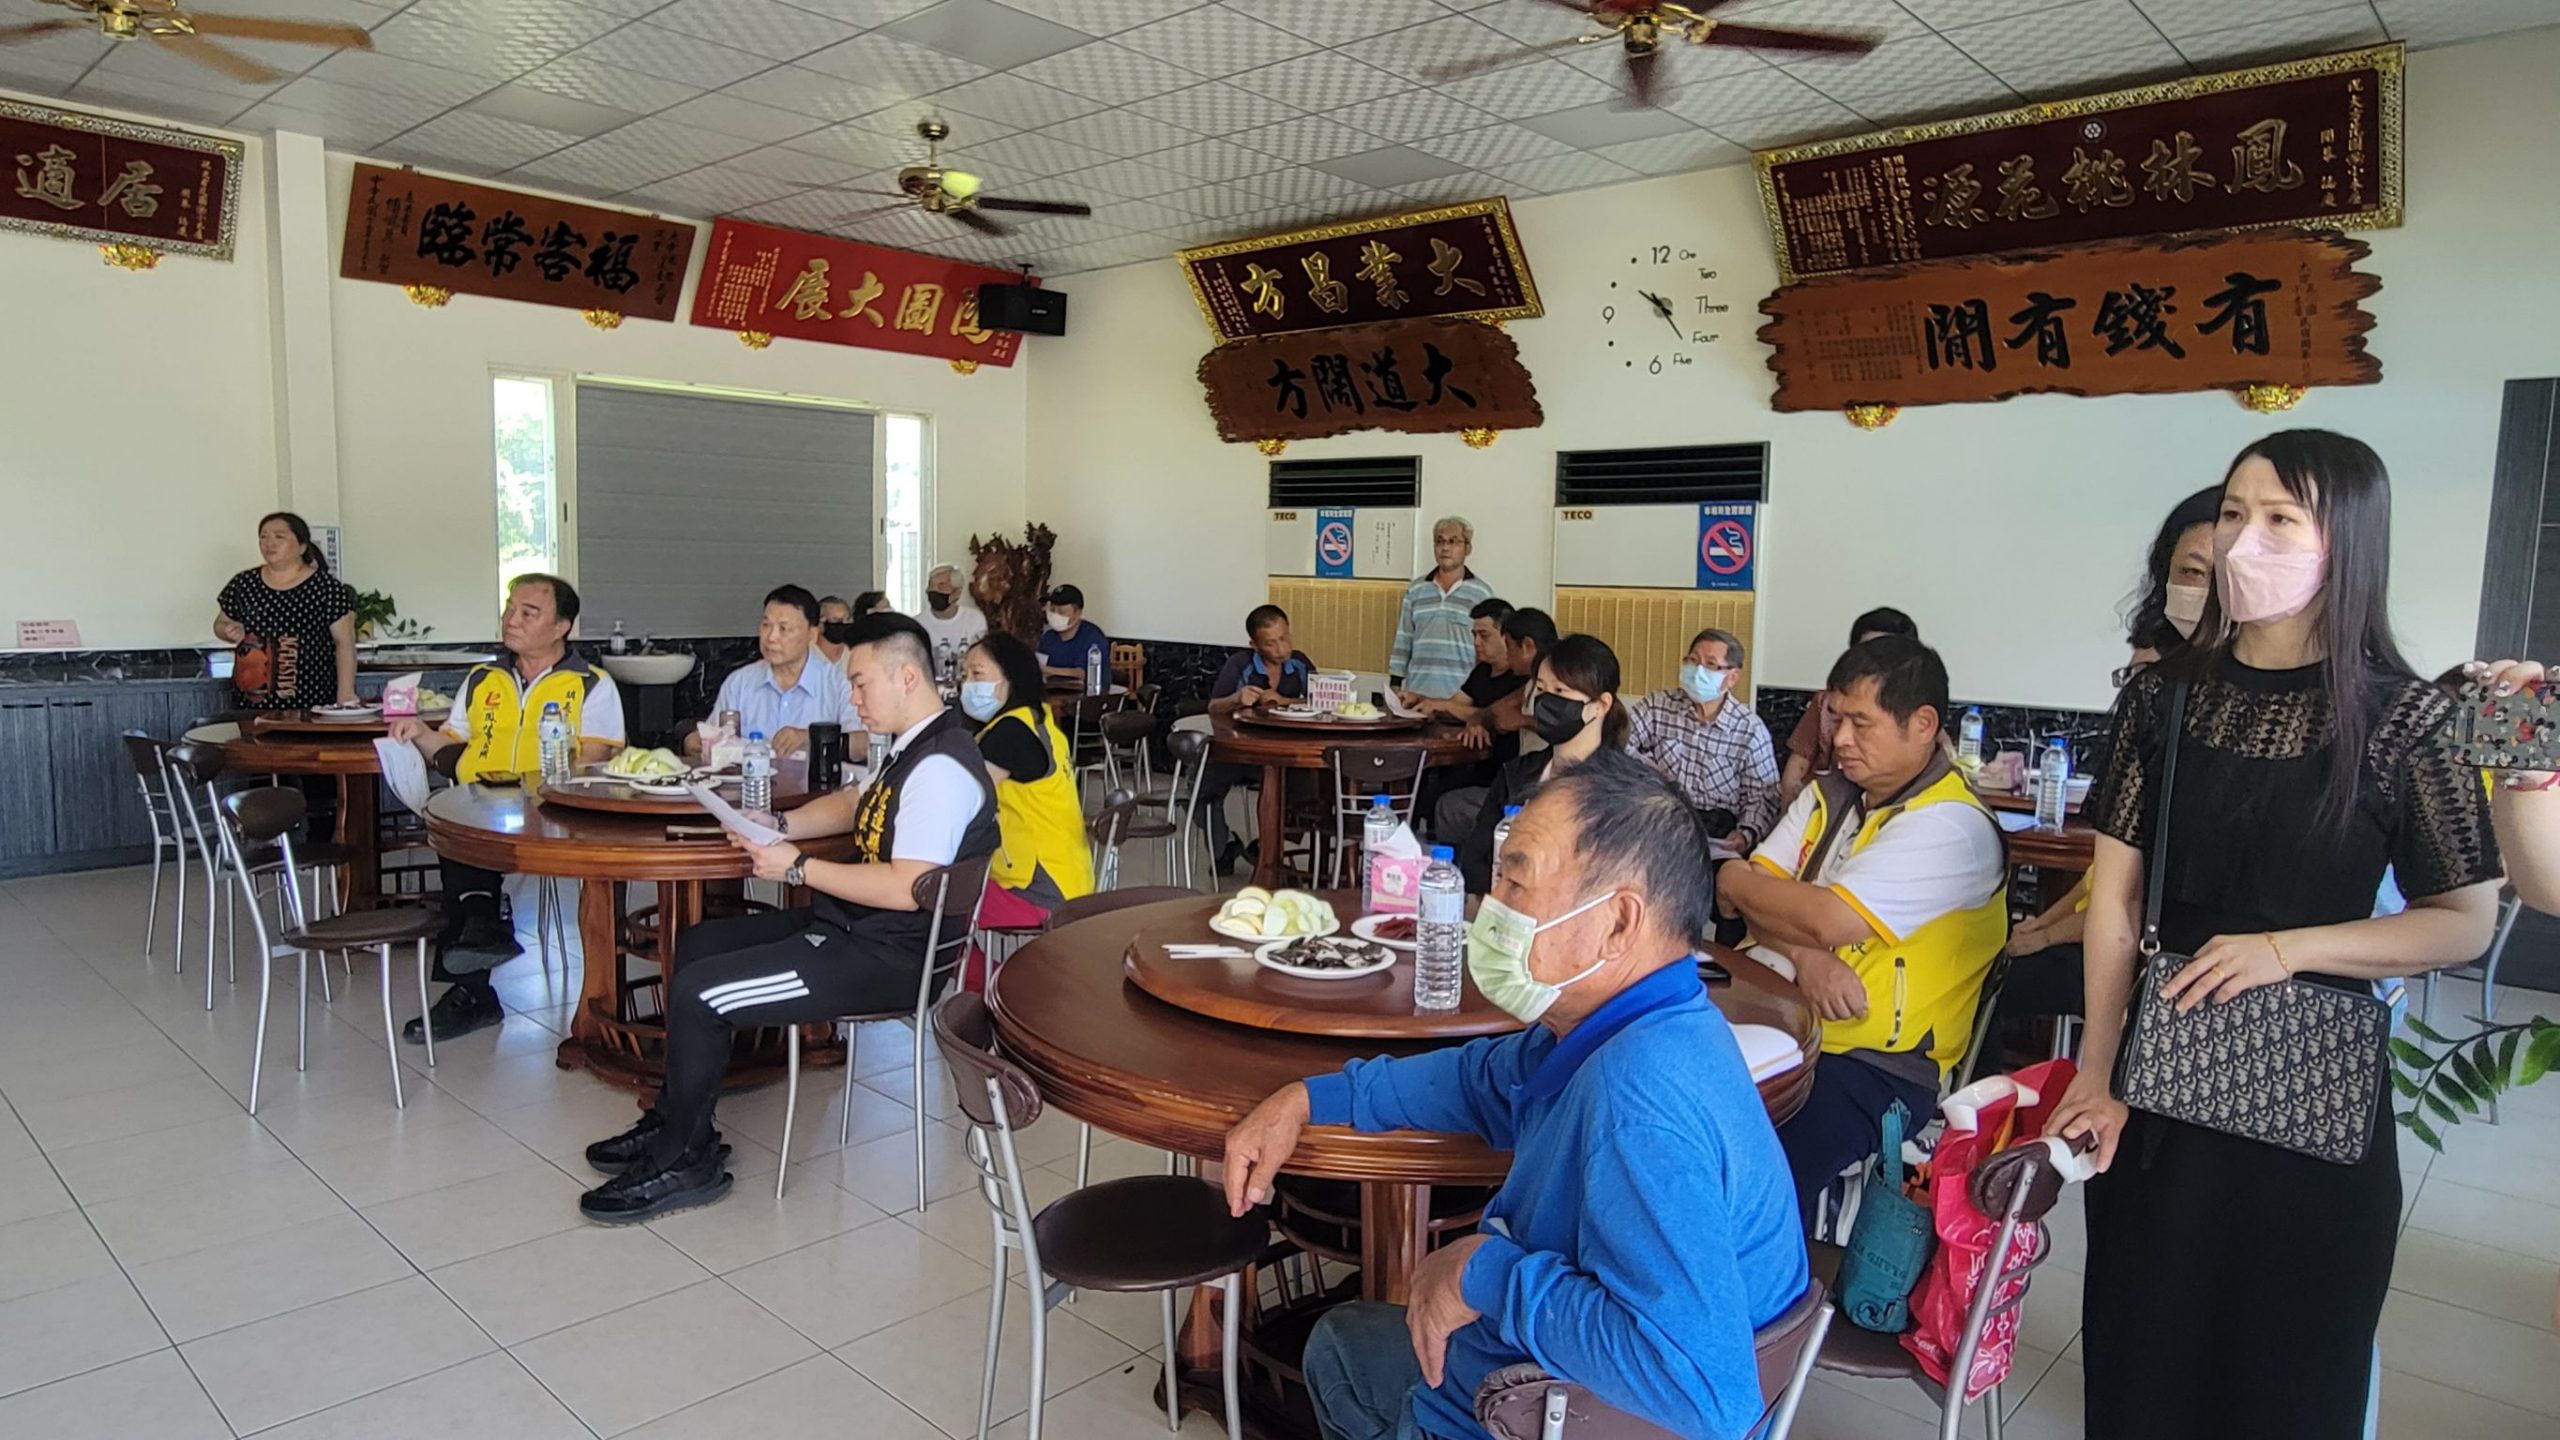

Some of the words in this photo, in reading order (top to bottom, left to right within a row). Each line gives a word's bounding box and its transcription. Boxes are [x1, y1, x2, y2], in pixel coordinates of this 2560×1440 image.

[1651, 245, 1671, 264] 12
[1678, 249, 1697, 261] One
[1698, 267, 1717, 280] Two
[1602, 305, 1615, 324] 9
[1695, 295, 1729, 314] Three
[1692, 330, 1720, 344] Four
[1648, 354, 1662, 375] 6
[1672, 352, 1693, 366] Five
[1274, 512, 1297, 521] TECO
[1562, 510, 1593, 520] TECO
